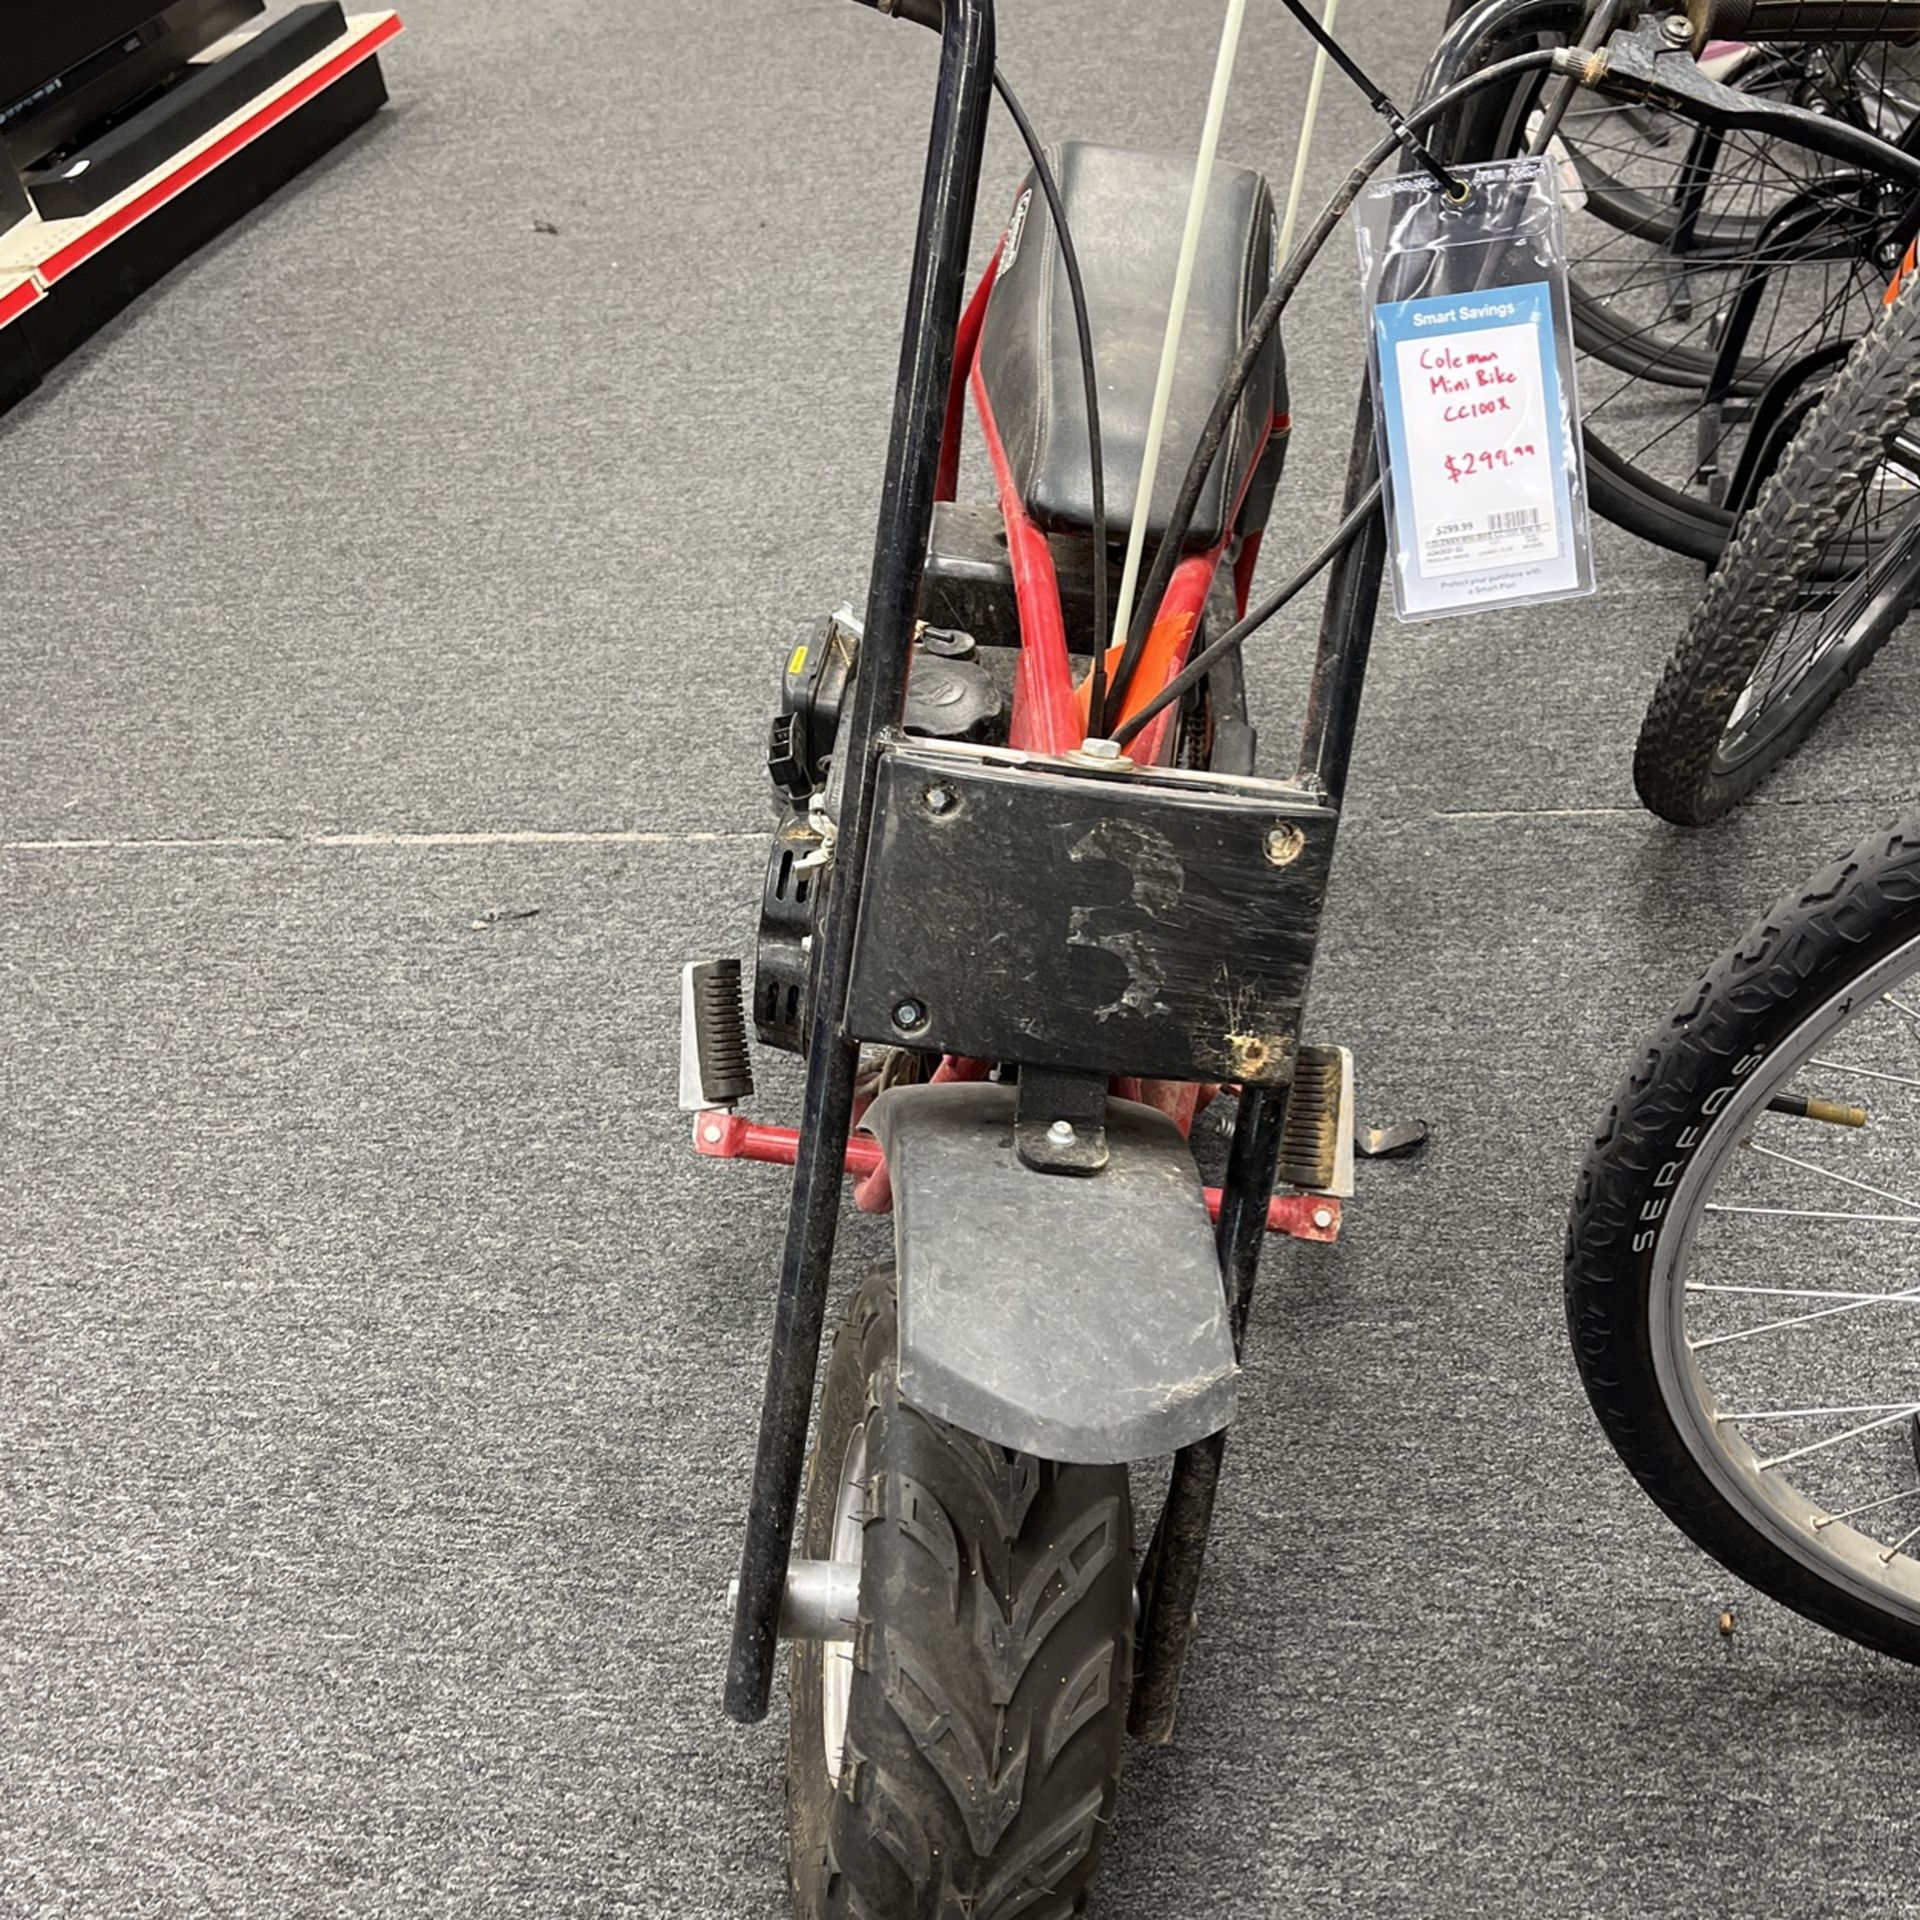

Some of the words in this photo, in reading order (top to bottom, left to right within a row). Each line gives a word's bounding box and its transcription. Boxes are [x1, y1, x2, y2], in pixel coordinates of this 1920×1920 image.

[1412, 308, 1456, 327] Smart
[1459, 302, 1515, 321] Savings
[1420, 347, 1498, 370] Coleman
[1429, 374, 1470, 395] Mini
[1475, 366, 1517, 387] Bike
[1444, 444, 1535, 483] $299.99
[1435, 521, 1474, 536] $299.99
[1440, 578, 1469, 589] Protect
[1470, 576, 1488, 587] your
[1474, 584, 1498, 594] Smart
[1499, 581, 1516, 591] Plan
[1632, 1053, 1764, 1252] SERFAS
